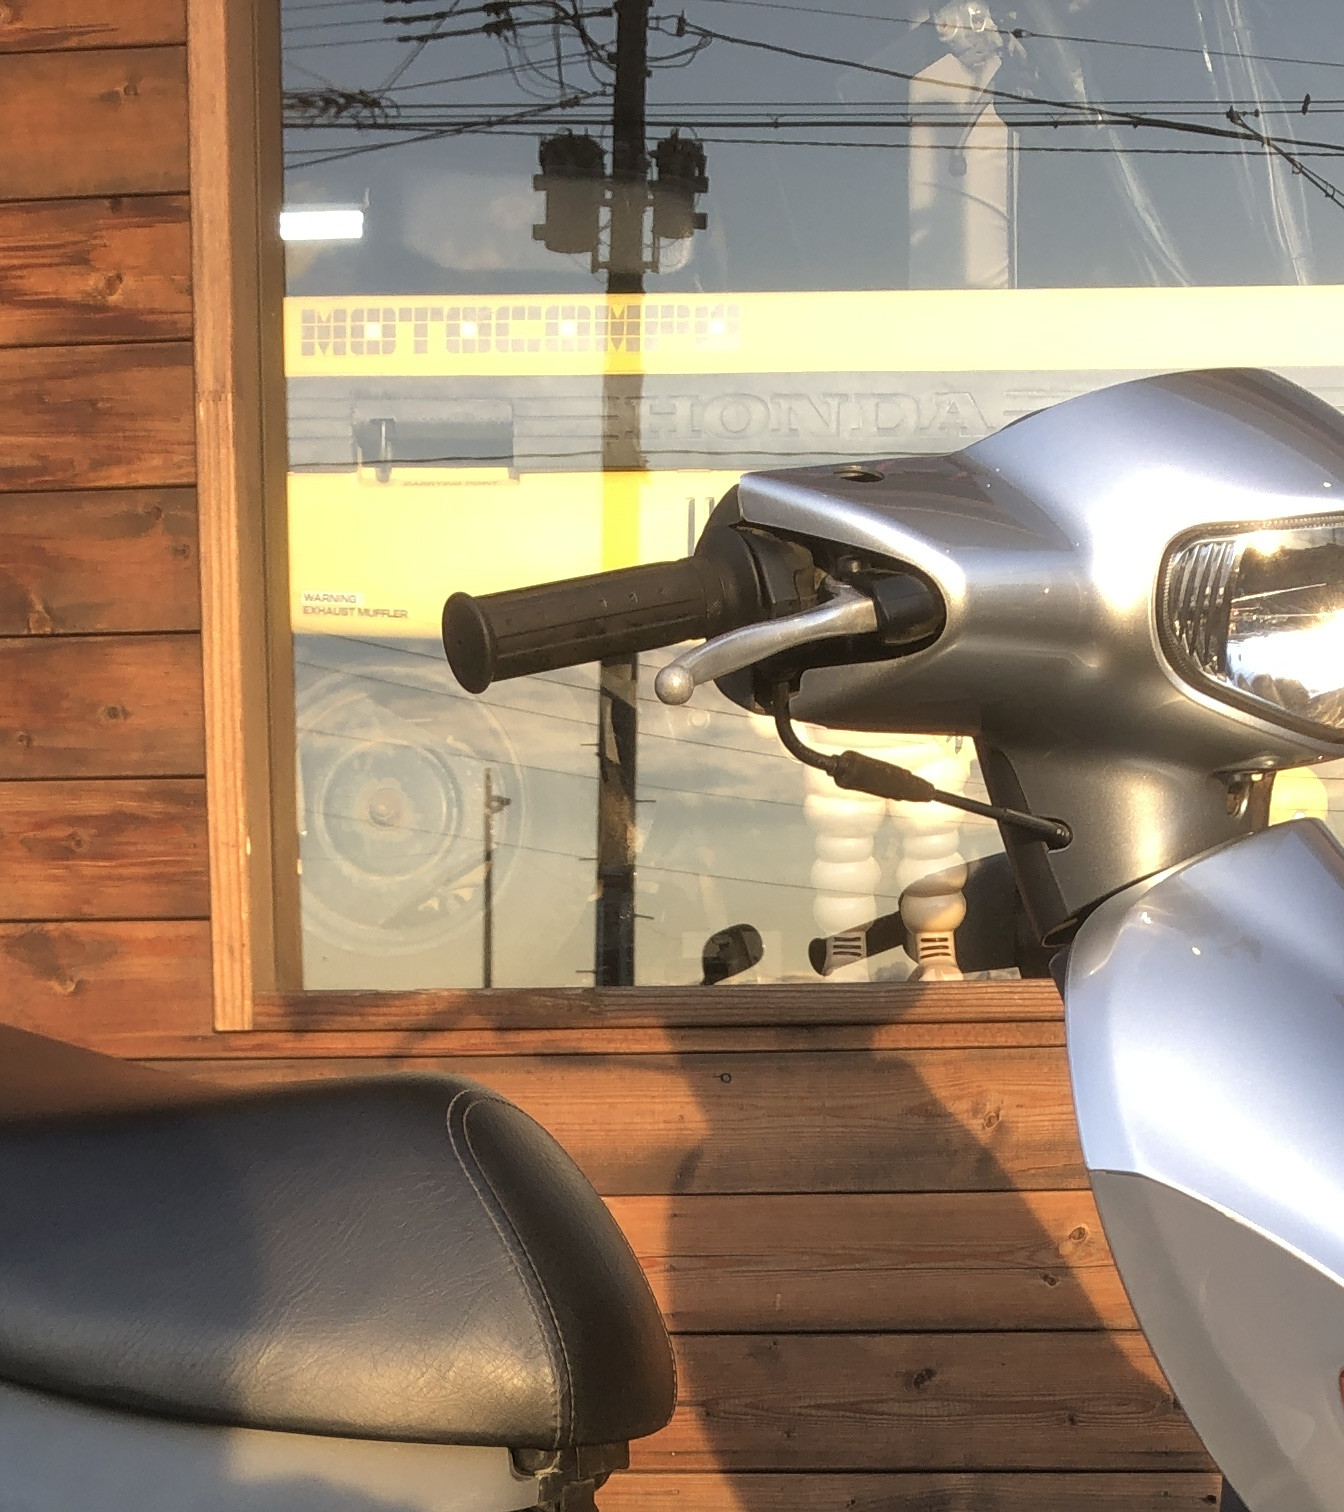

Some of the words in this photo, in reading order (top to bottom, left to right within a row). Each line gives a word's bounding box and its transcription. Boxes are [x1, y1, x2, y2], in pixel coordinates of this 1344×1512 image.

[301, 302, 740, 356] MOTOCOMPO
[624, 391, 996, 440] HONDA
[302, 605, 356, 616] EXHAUST
[357, 607, 408, 618] MUFFLER
[303, 593, 357, 603] WARNING
